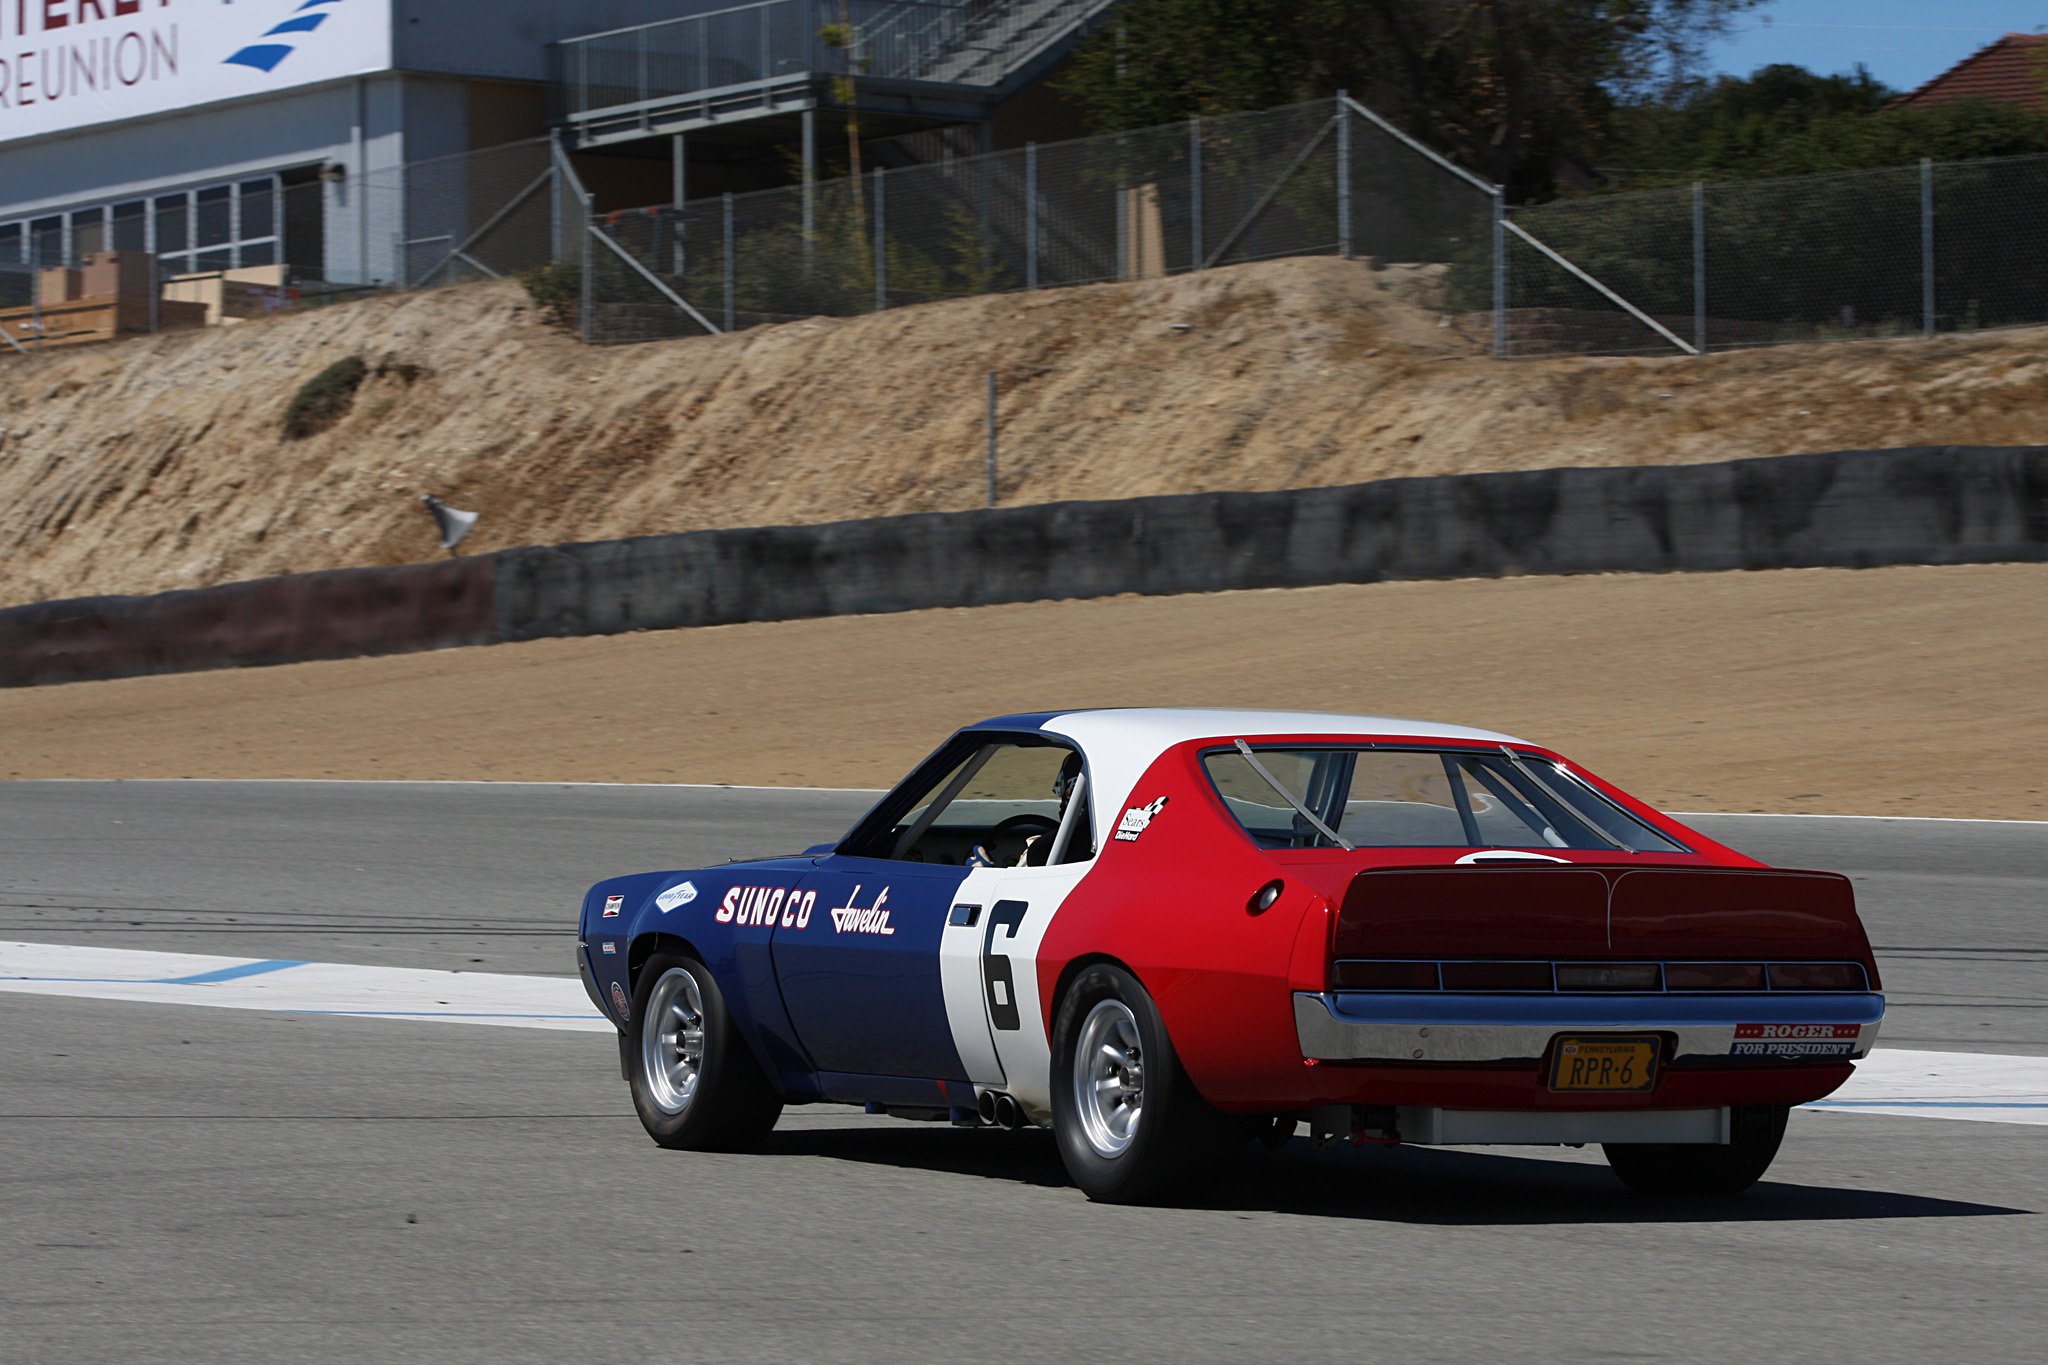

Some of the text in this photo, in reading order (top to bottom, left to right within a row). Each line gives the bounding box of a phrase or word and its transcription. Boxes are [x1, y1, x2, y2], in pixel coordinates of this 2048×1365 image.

[1122, 812, 1145, 828] Sears
[715, 886, 817, 929] SUNOCO
[831, 884, 896, 935] Javelin
[983, 899, 1029, 1030] 6
[1761, 1025, 1835, 1038] ROGER
[1579, 1045, 1636, 1054] PENNSYLVANIA
[1734, 1043, 1851, 1055] FOR PRESIDENT
